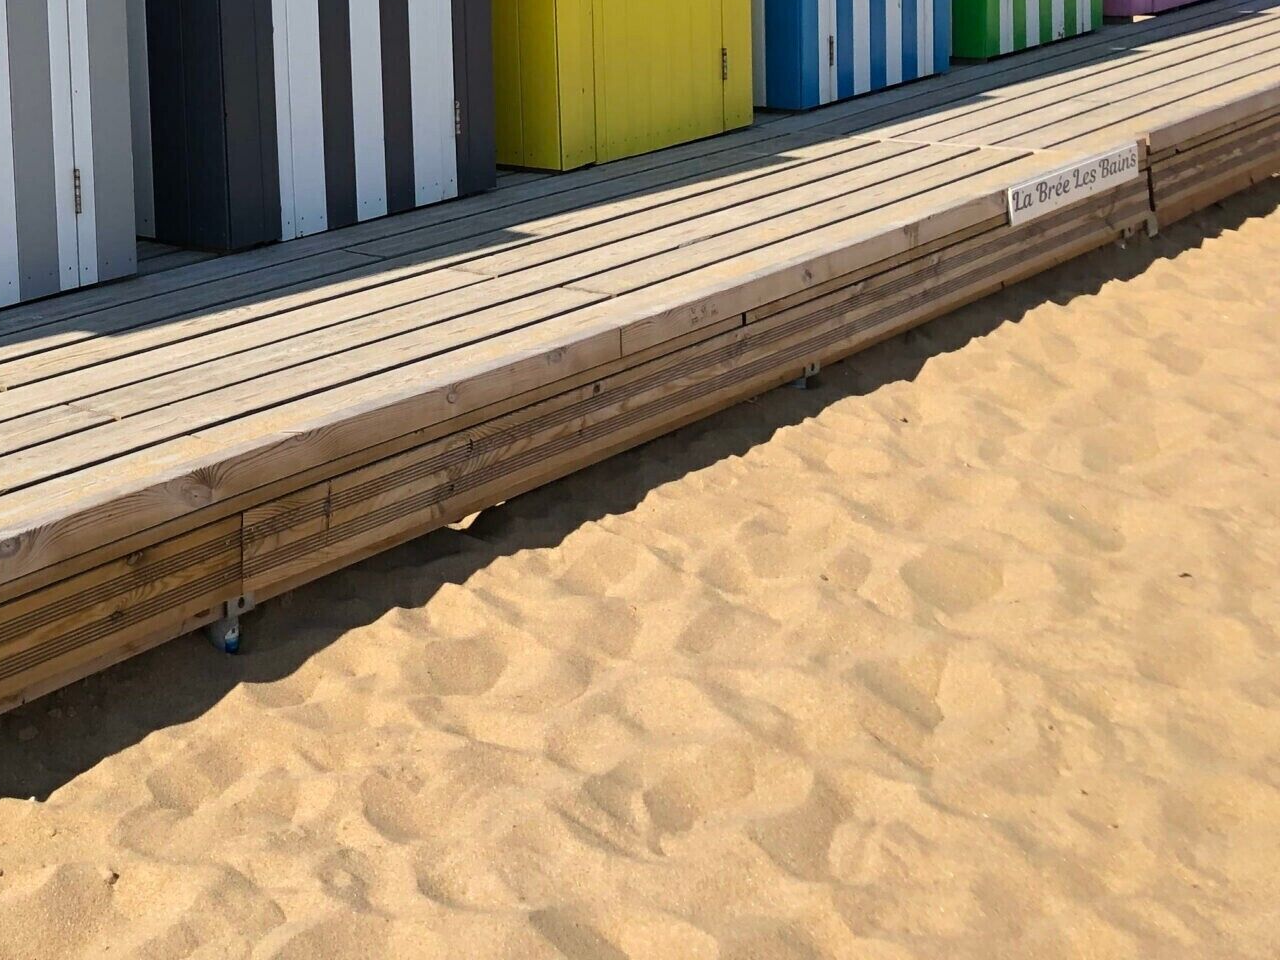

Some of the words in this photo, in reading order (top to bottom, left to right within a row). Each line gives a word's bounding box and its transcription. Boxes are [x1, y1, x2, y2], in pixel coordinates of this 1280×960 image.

[1013, 191, 1033, 212] La
[1036, 176, 1070, 203] Brée
[1073, 168, 1097, 189] Les
[1099, 153, 1137, 179] Bains
